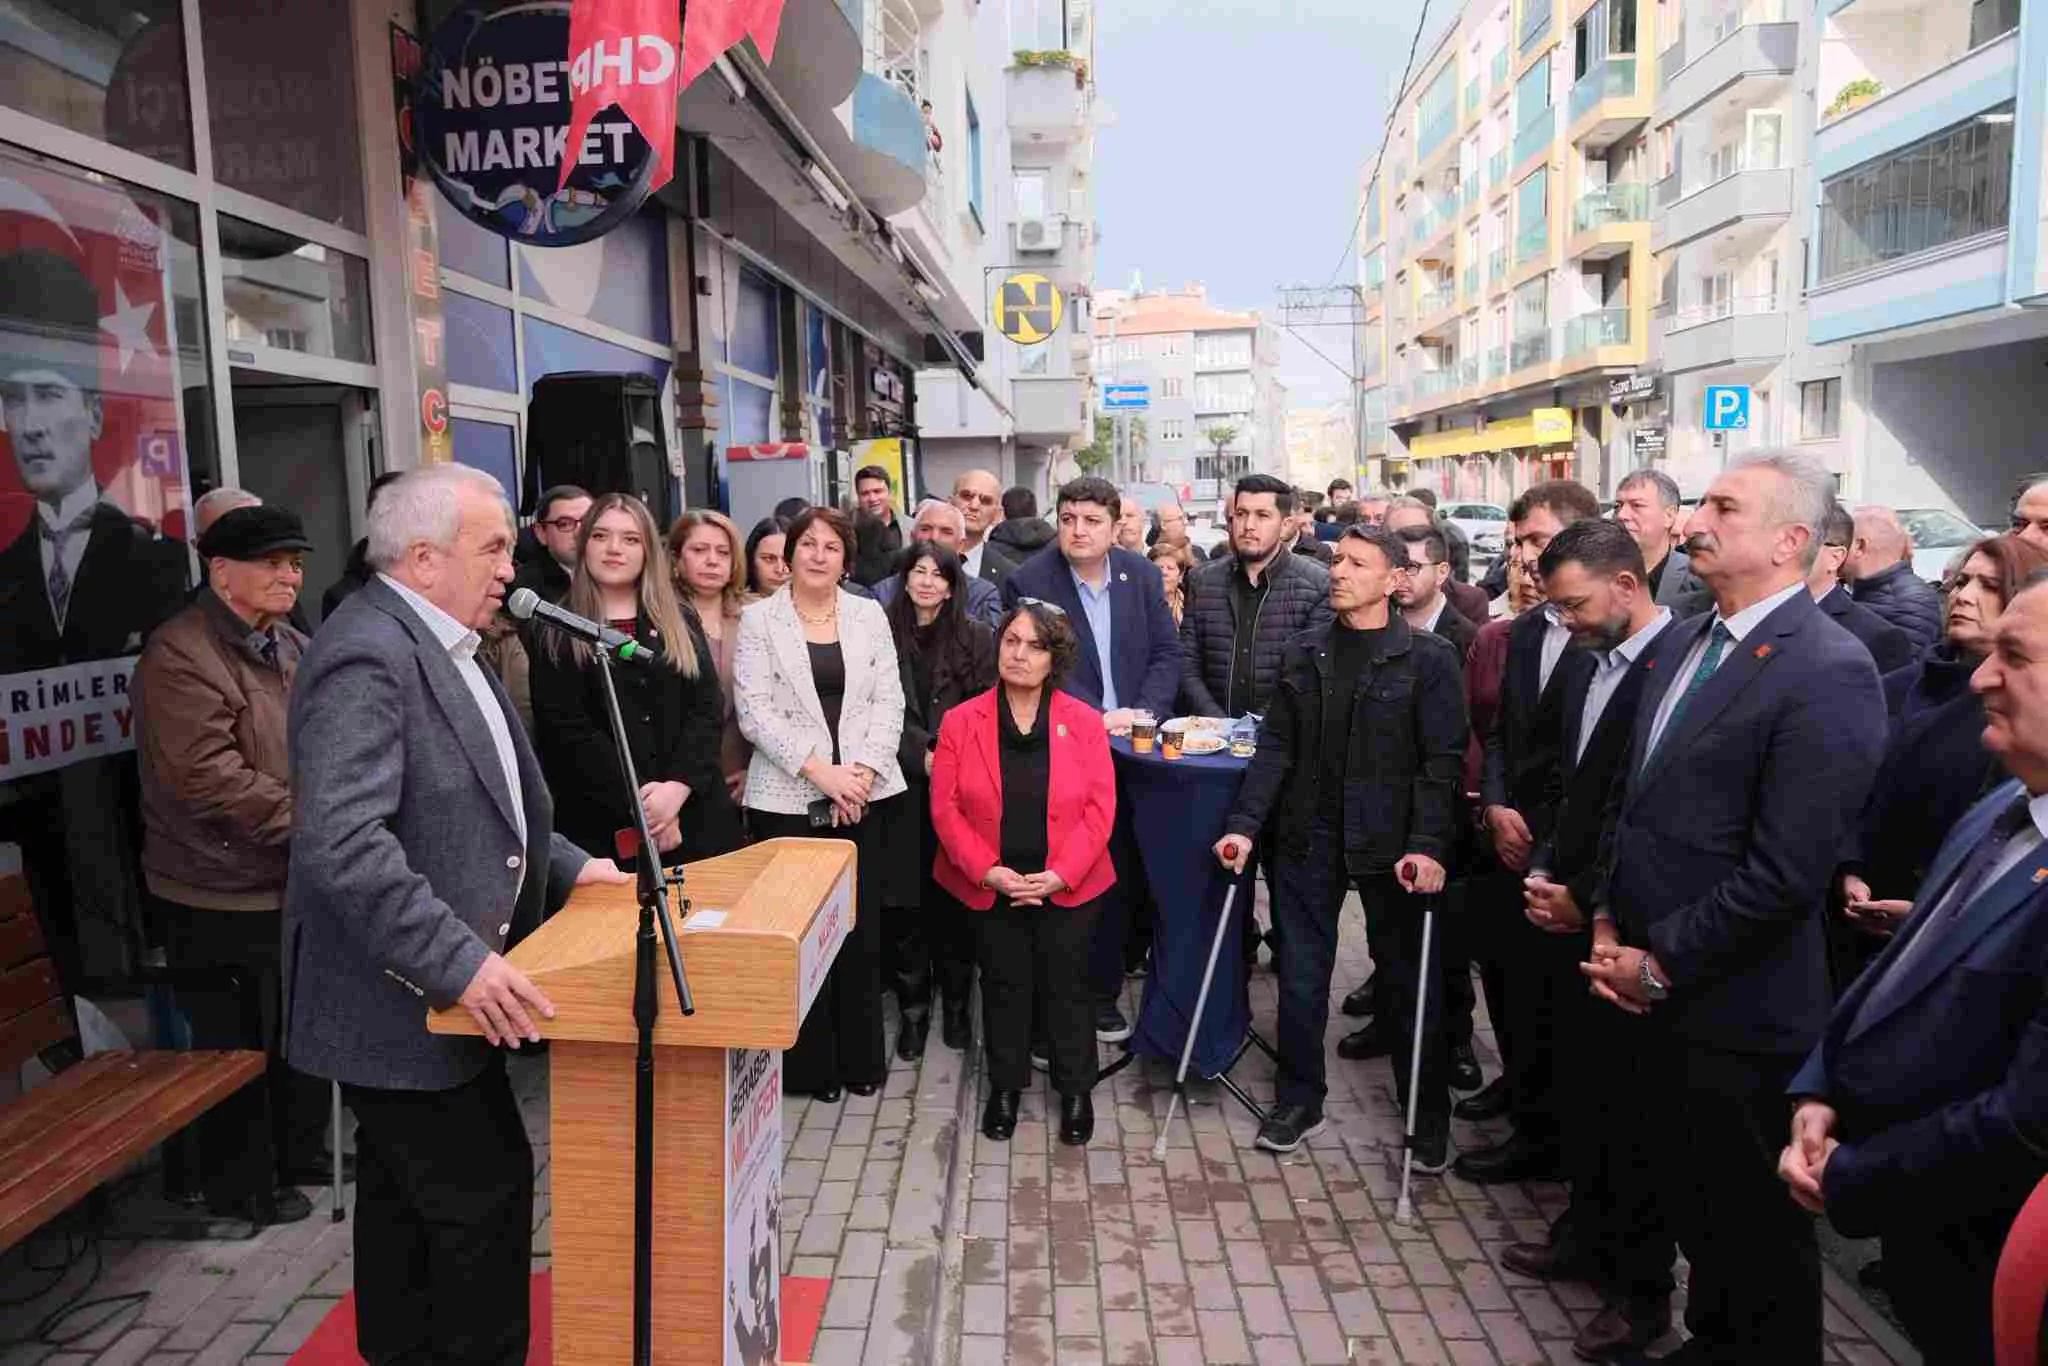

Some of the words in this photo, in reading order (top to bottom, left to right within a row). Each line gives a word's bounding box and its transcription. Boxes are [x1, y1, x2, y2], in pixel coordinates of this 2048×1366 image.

[443, 56, 570, 109] NÖBE
[444, 122, 633, 173] MARKET
[1714, 389, 1741, 427] P
[0, 673, 129, 713] RİMLER
